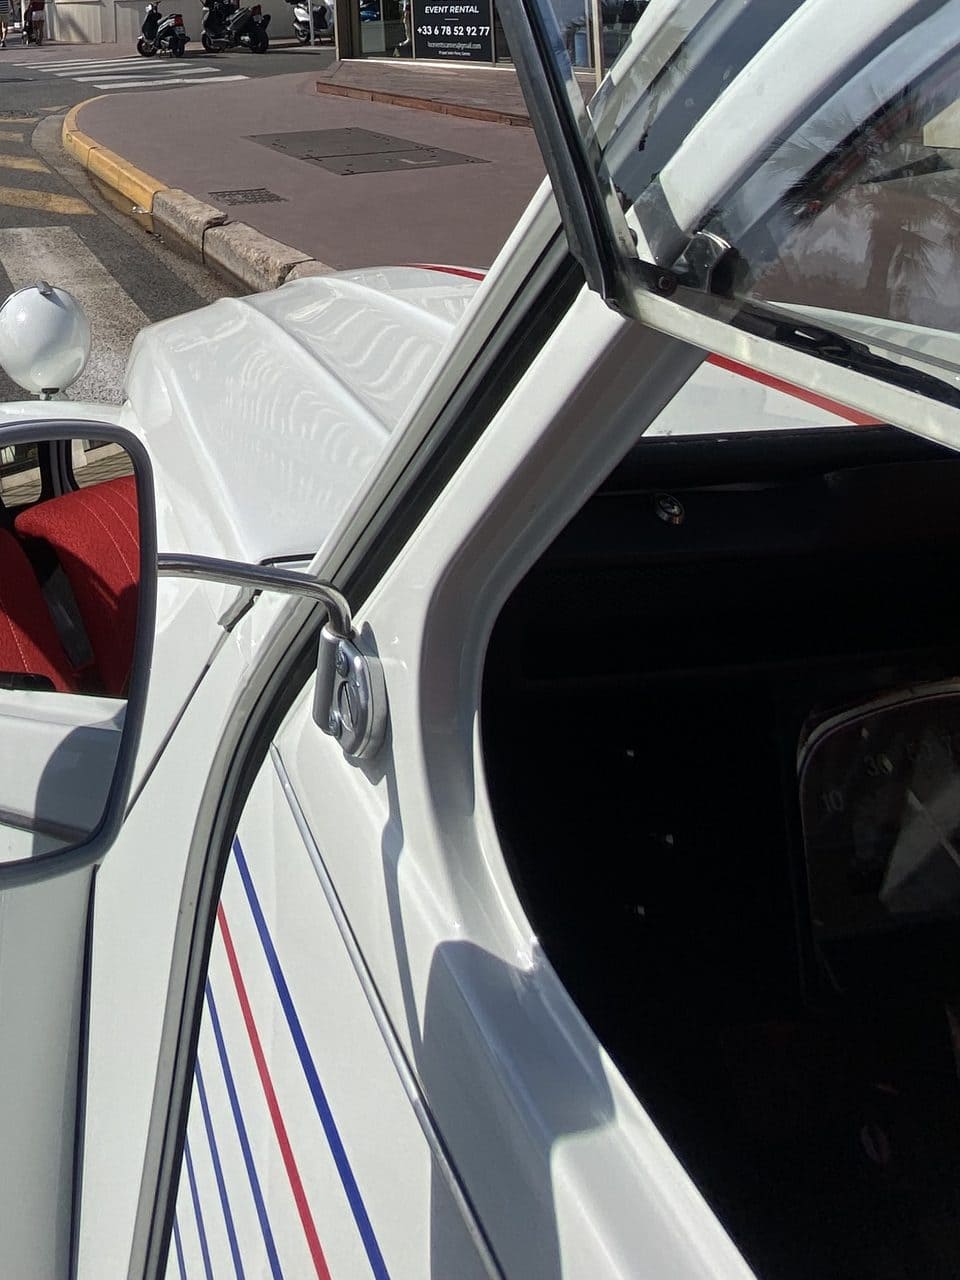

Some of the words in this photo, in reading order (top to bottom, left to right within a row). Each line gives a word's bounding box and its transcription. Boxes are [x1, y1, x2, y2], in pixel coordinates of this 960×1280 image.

[424, 5, 449, 14] EVENT
[450, 5, 480, 14] RENTAL
[417, 26, 432, 35] +33
[433, 26, 440, 35] 6
[441, 26, 452, 36] 78
[453, 27, 465, 36] 52
[466, 27, 478, 36] 92
[479, 27, 491, 37] 77
